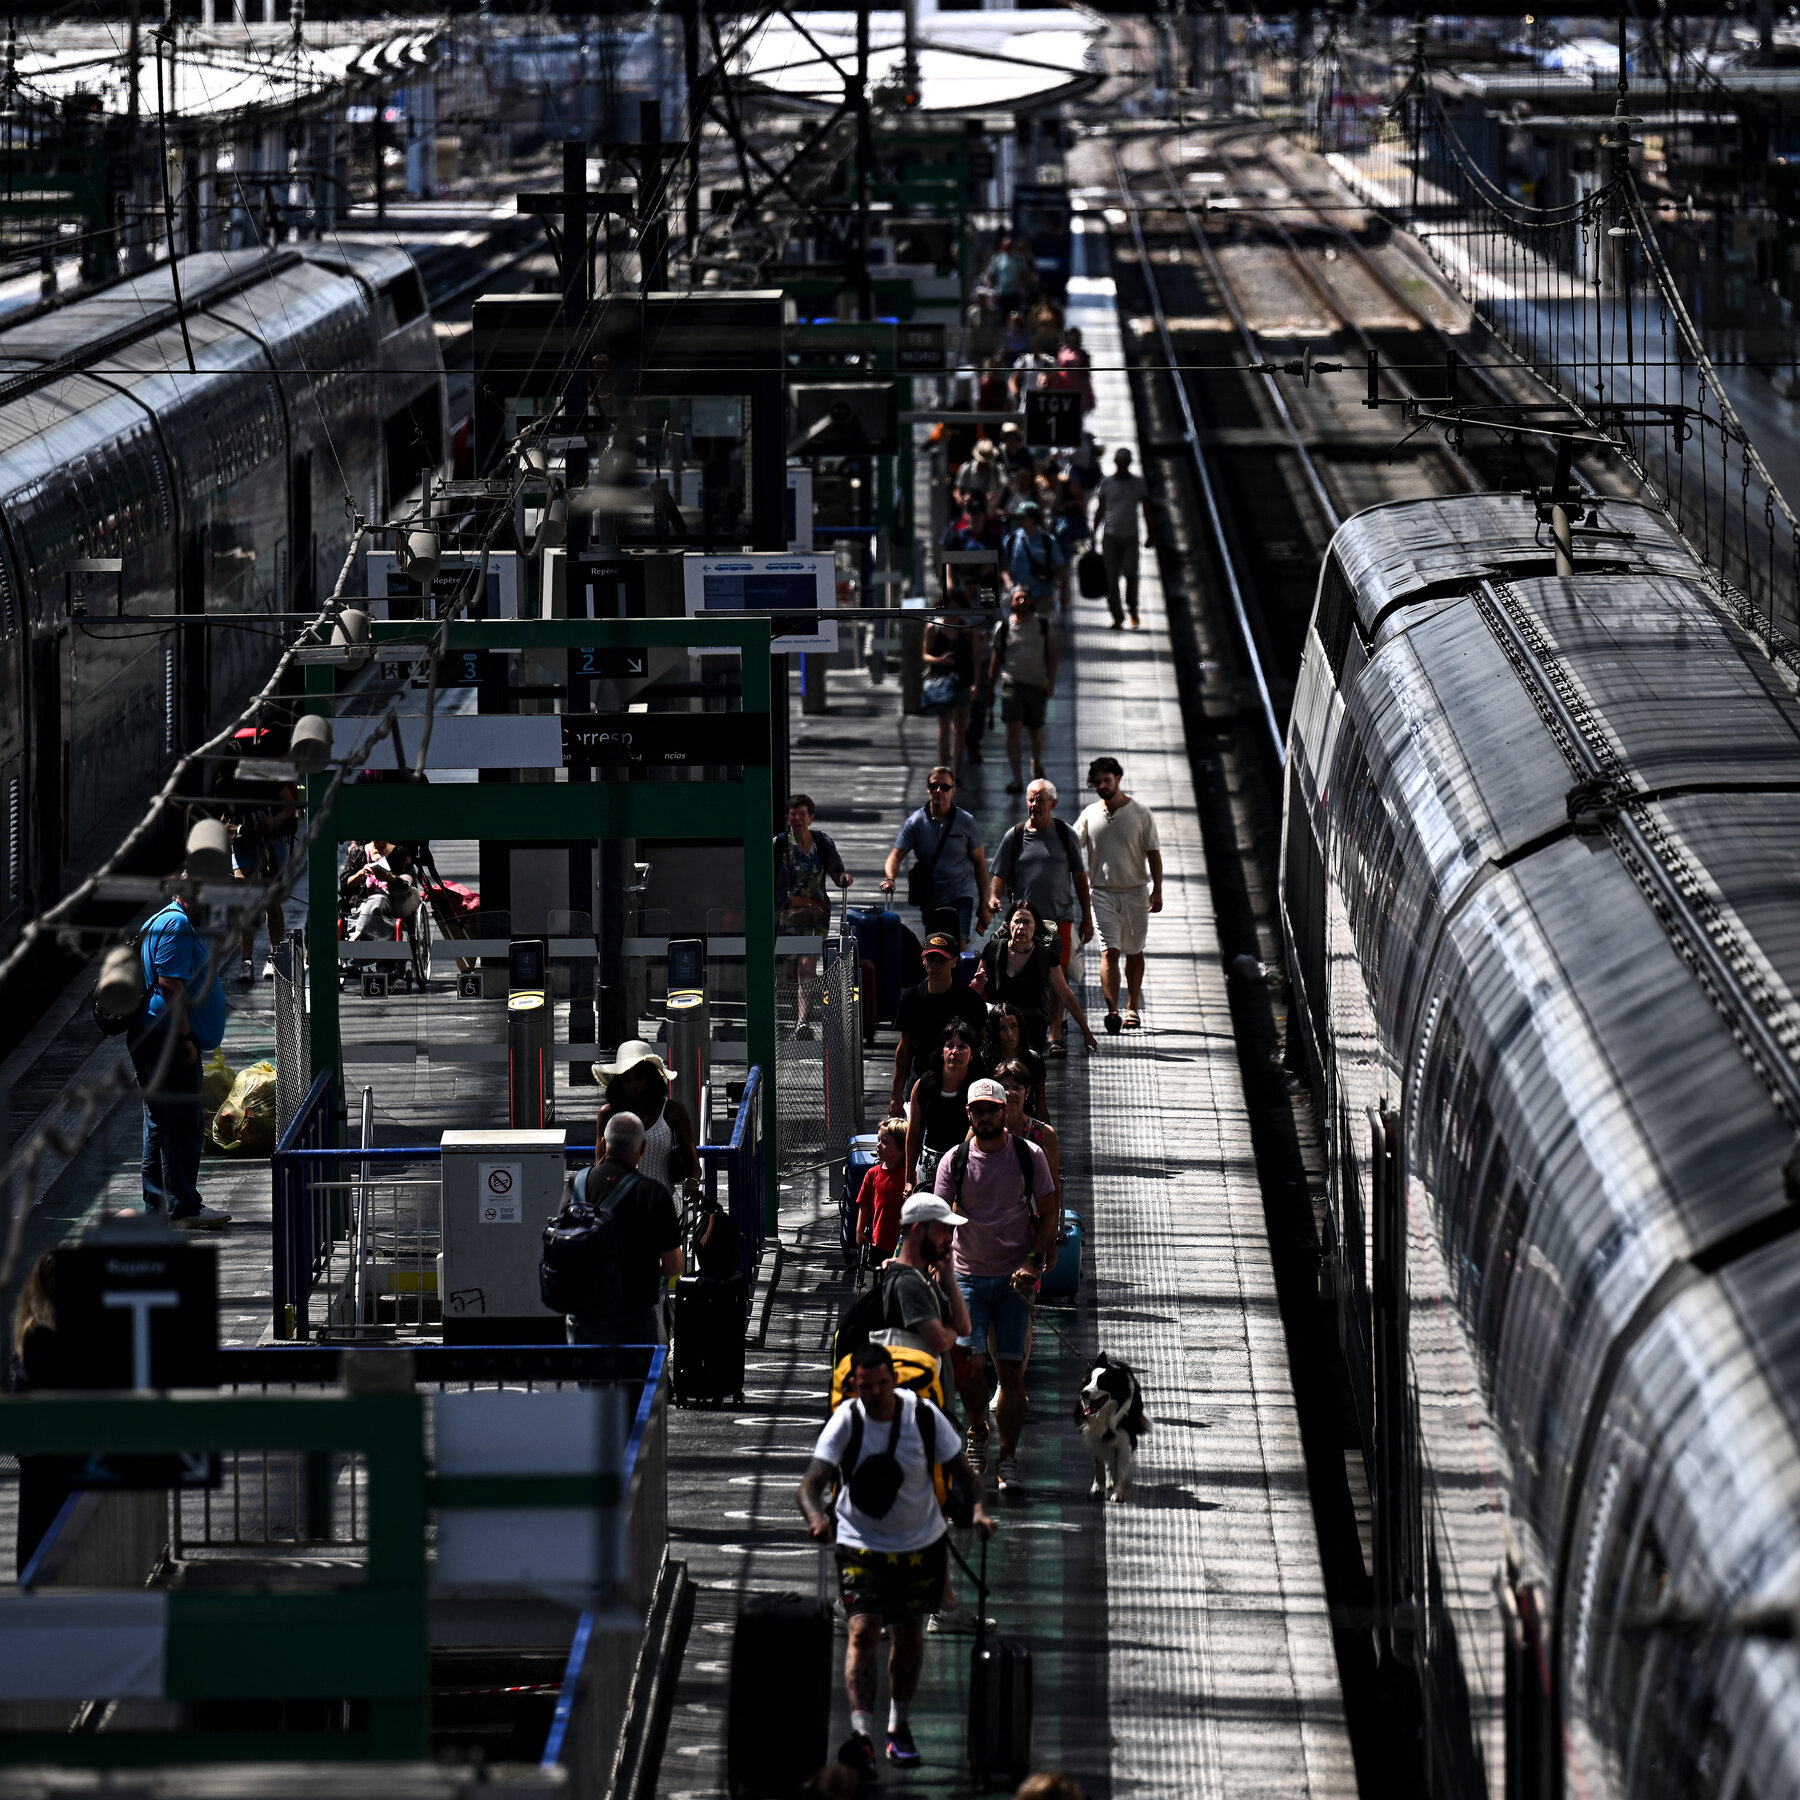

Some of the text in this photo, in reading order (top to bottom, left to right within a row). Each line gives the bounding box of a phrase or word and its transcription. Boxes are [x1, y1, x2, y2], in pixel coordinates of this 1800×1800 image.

[1037, 395, 1072, 413] TGV
[1046, 415, 1057, 442] 1
[464, 661, 477, 680] 3
[582, 654, 595, 672] 2
[102, 1289, 181, 1392] T
